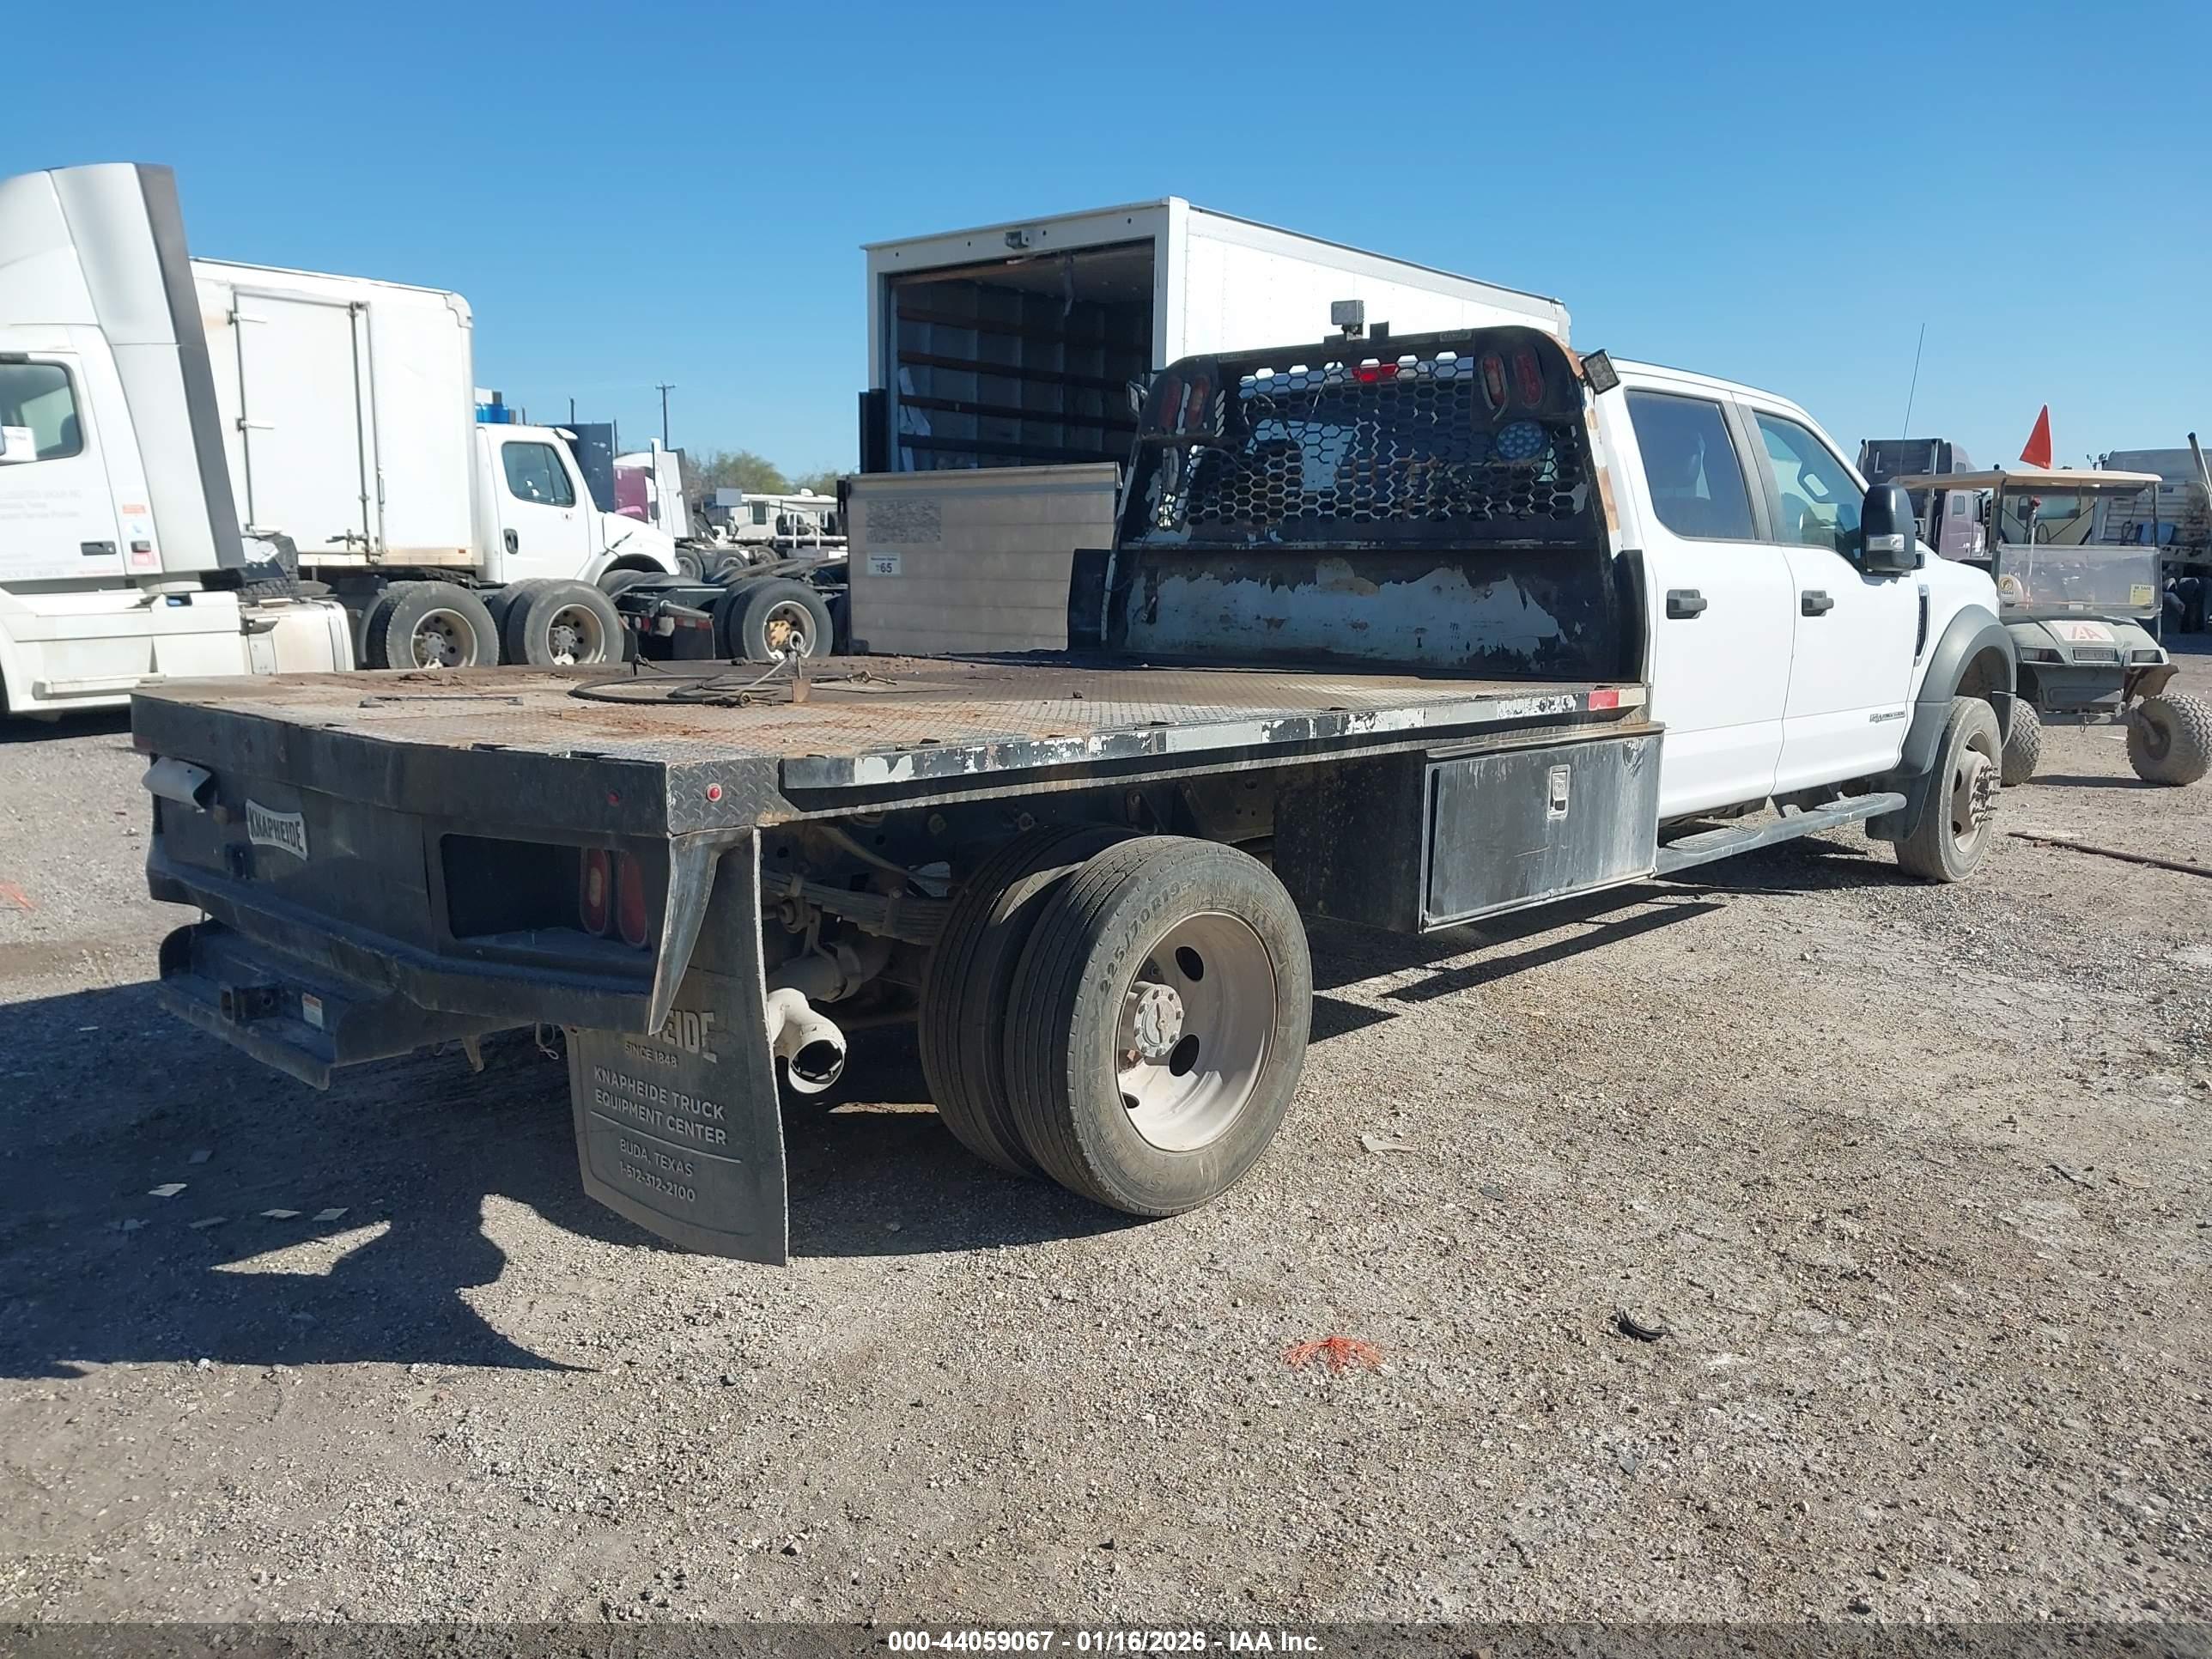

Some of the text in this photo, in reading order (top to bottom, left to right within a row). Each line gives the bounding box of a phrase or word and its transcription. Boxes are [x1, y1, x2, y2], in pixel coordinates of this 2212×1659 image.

[248, 807, 304, 853] KNAPHEIDE
[625, 1042, 678, 1068] SINCE 1848
[594, 1066, 725, 1121] KNAPHEIDE TRUCK
[595, 1089, 727, 1146] EQUIPMENT CENTER
[619, 1139, 693, 1177] BUDA, TEXAS
[619, 1161, 696, 1202] 1-512-312-2100
